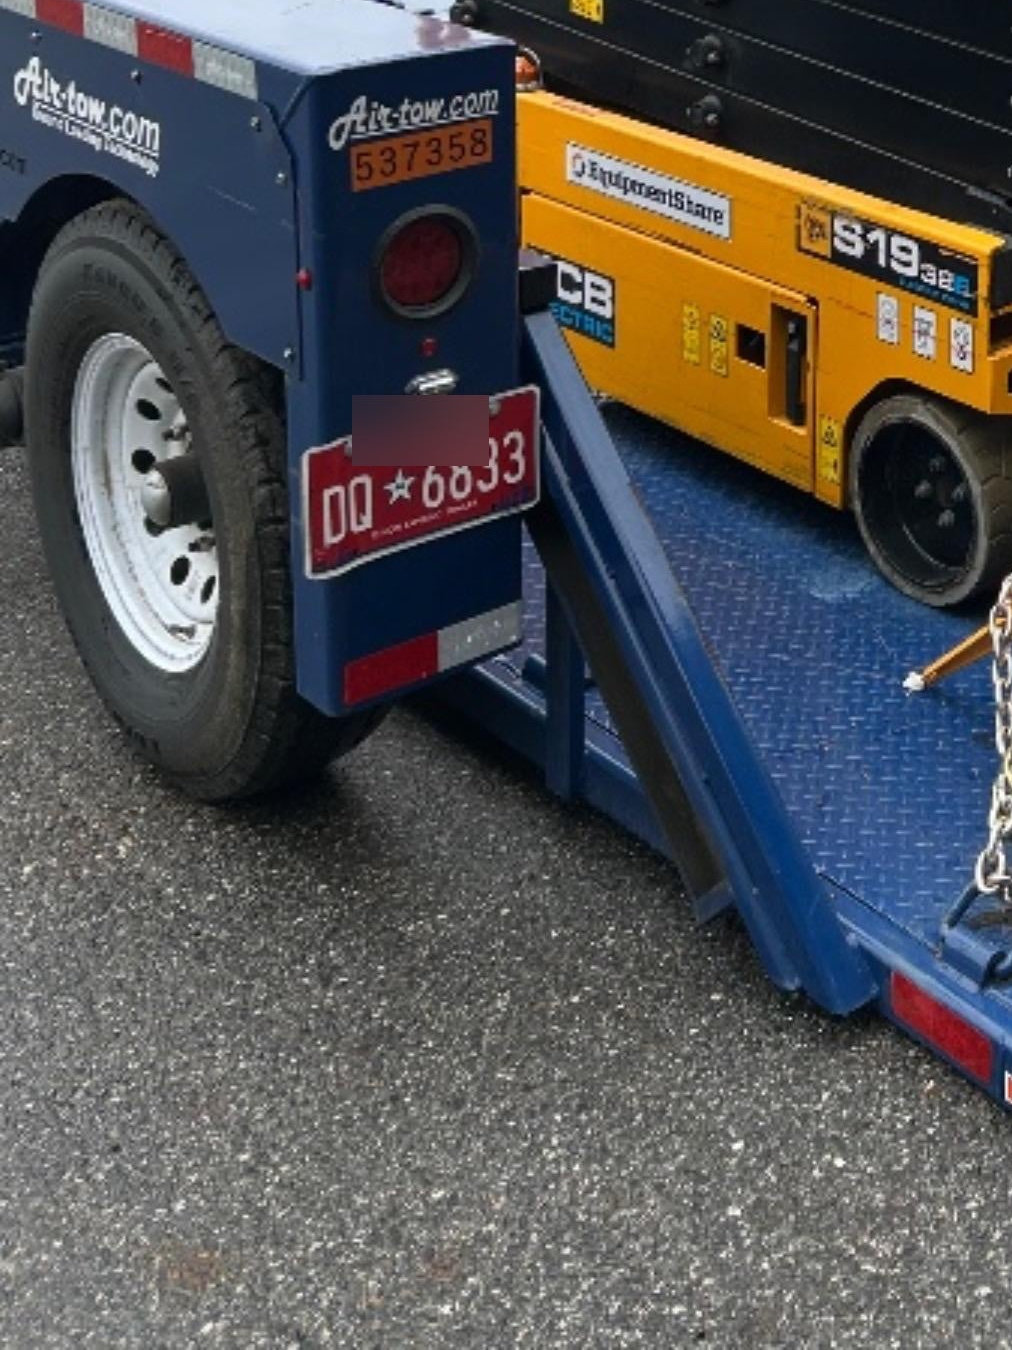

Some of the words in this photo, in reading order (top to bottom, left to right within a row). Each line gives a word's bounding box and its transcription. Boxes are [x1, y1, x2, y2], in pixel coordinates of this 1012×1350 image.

[14, 56, 160, 151] Air-tow.com
[329, 90, 498, 150] Air-tow.com
[355, 129, 487, 181] 537358
[588, 159, 724, 225] EquipmentShare
[557, 262, 613, 319] CB
[323, 474, 372, 545] DQ
